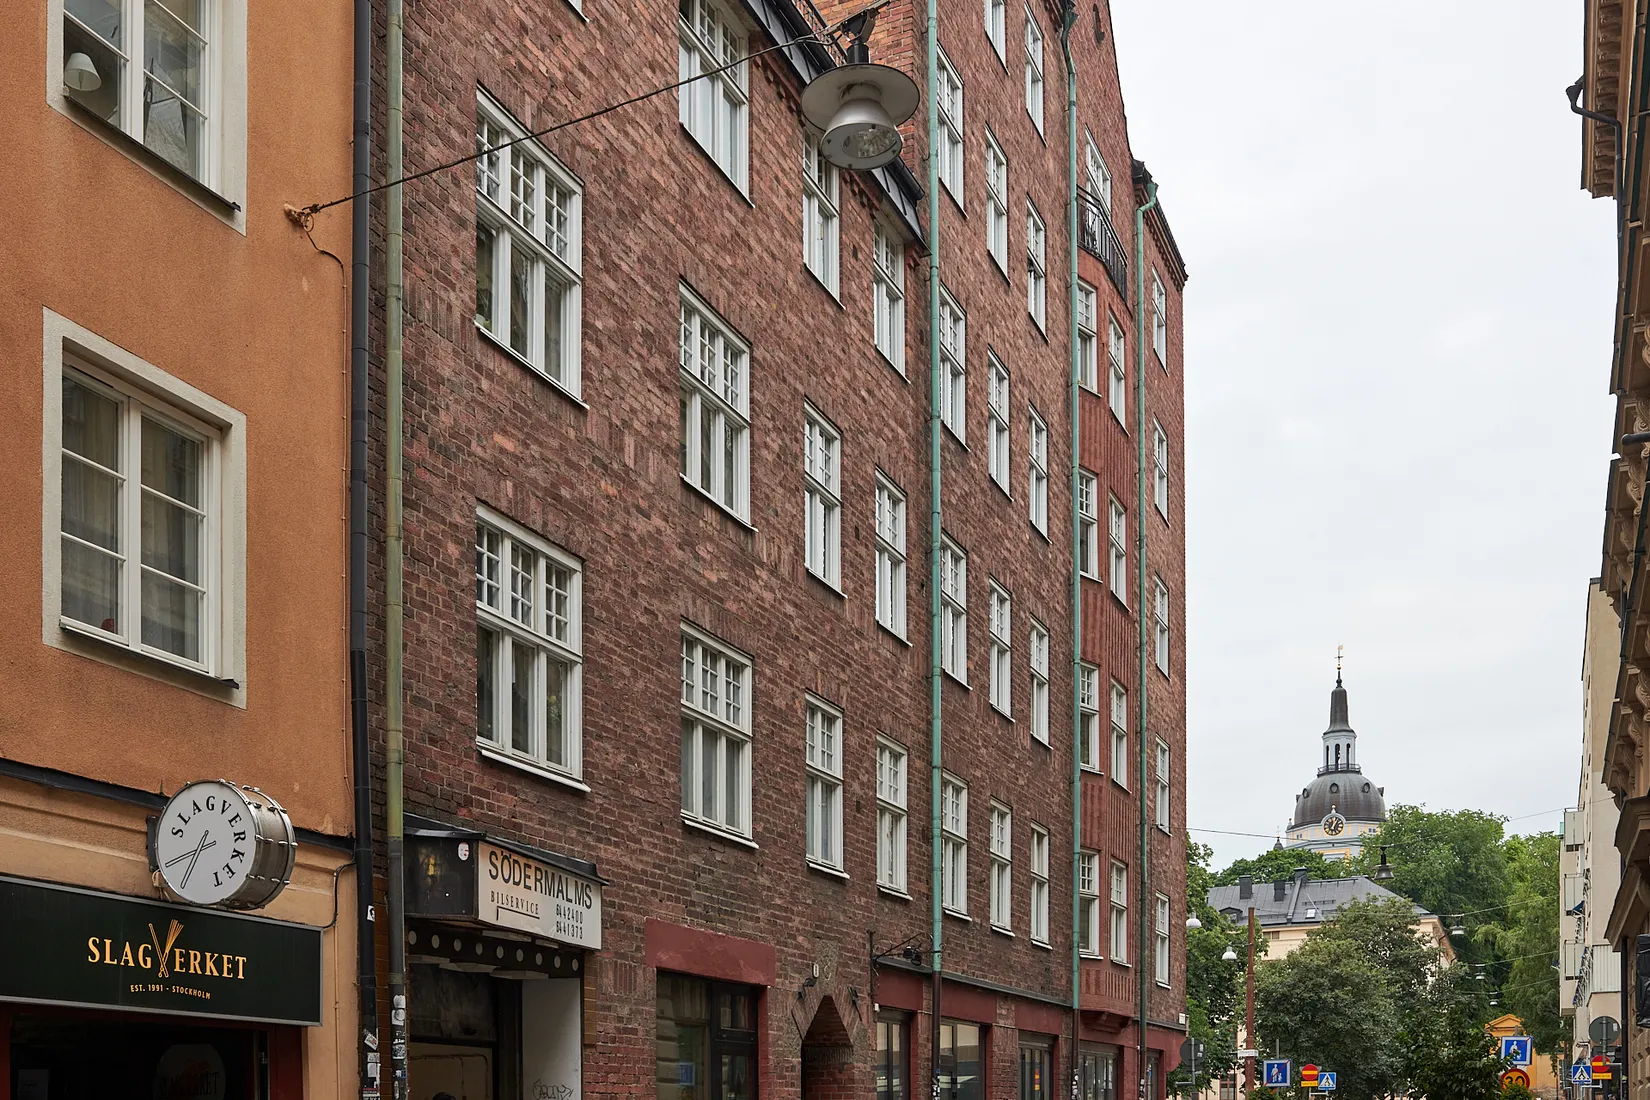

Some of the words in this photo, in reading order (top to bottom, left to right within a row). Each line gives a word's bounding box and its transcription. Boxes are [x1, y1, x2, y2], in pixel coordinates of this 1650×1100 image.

[171, 795, 246, 887] SLAGVERKET
[488, 850, 592, 909] SÖDERMALMS
[490, 890, 539, 915] BILSERVICE
[87, 920, 248, 979] SLAGVERKET
[130, 984, 146, 993] EST.
[148, 984, 163, 992] 1991
[171, 985, 211, 1000] STOCKHOLM
